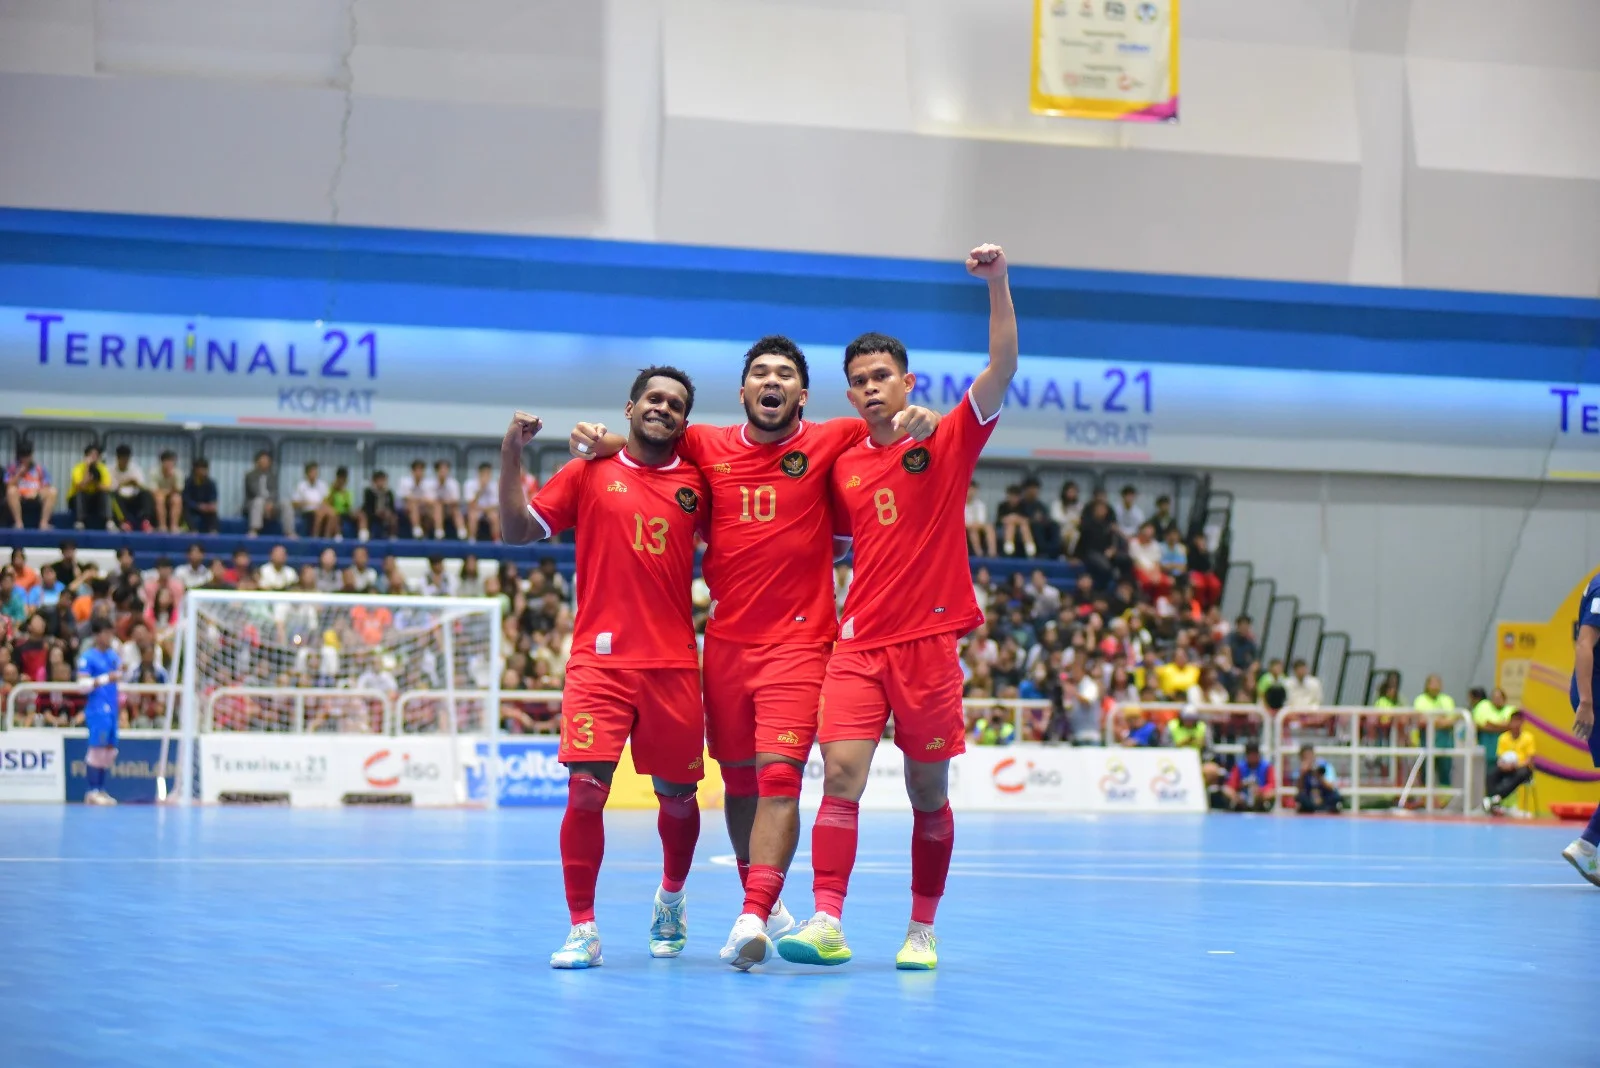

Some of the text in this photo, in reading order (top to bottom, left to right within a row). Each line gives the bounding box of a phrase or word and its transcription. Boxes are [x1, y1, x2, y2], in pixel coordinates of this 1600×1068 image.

[321, 329, 378, 379] 21
[278, 386, 377, 414] KORAT
[1103, 367, 1153, 413] 21
[1065, 421, 1151, 446] KORAT
[739, 485, 776, 522] 10
[873, 488, 898, 526] 8
[632, 512, 670, 555] 13
[0, 750, 55, 770] SDF
